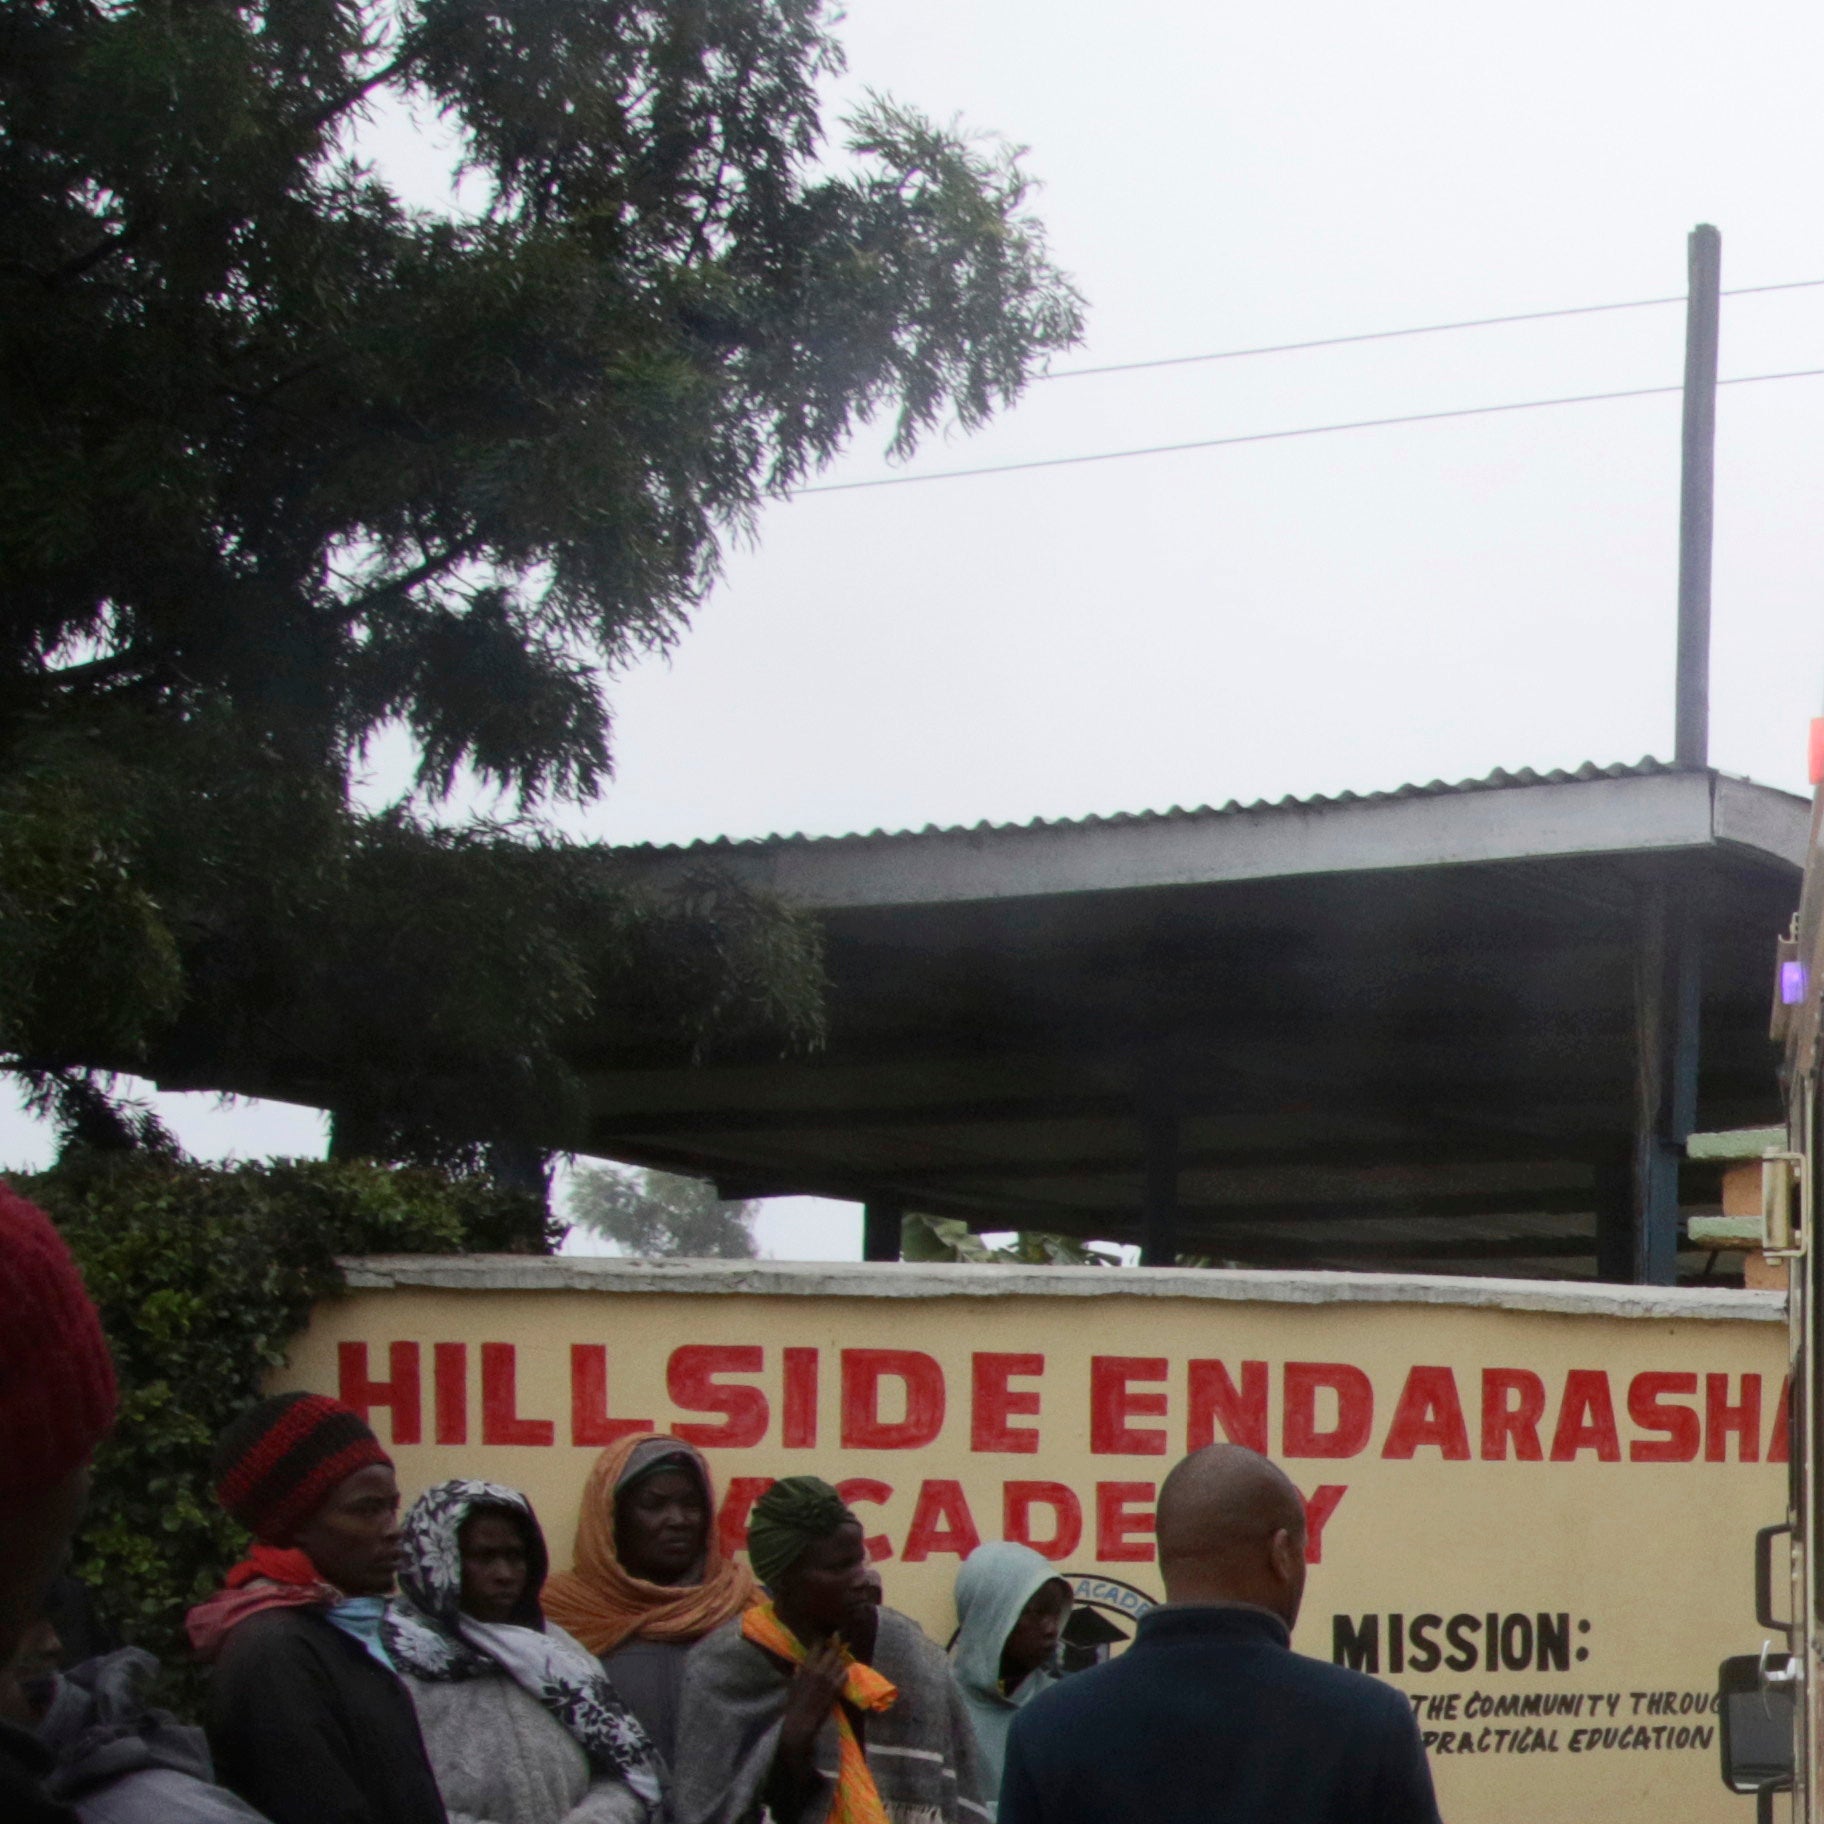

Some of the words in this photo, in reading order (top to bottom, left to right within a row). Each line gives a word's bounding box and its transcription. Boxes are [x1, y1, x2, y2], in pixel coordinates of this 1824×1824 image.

[337, 1341, 1045, 1454] HILLSIDE
[1089, 1355, 1789, 1463] ENDARASH
[1332, 1612, 1591, 1674] MISSION:
[1409, 1693, 1458, 1721] THE
[1463, 1690, 1621, 1719] COMMUNITY
[1423, 1726, 1560, 1756] PRACTICAL
[1567, 1725, 1714, 1753] EDUCATION
